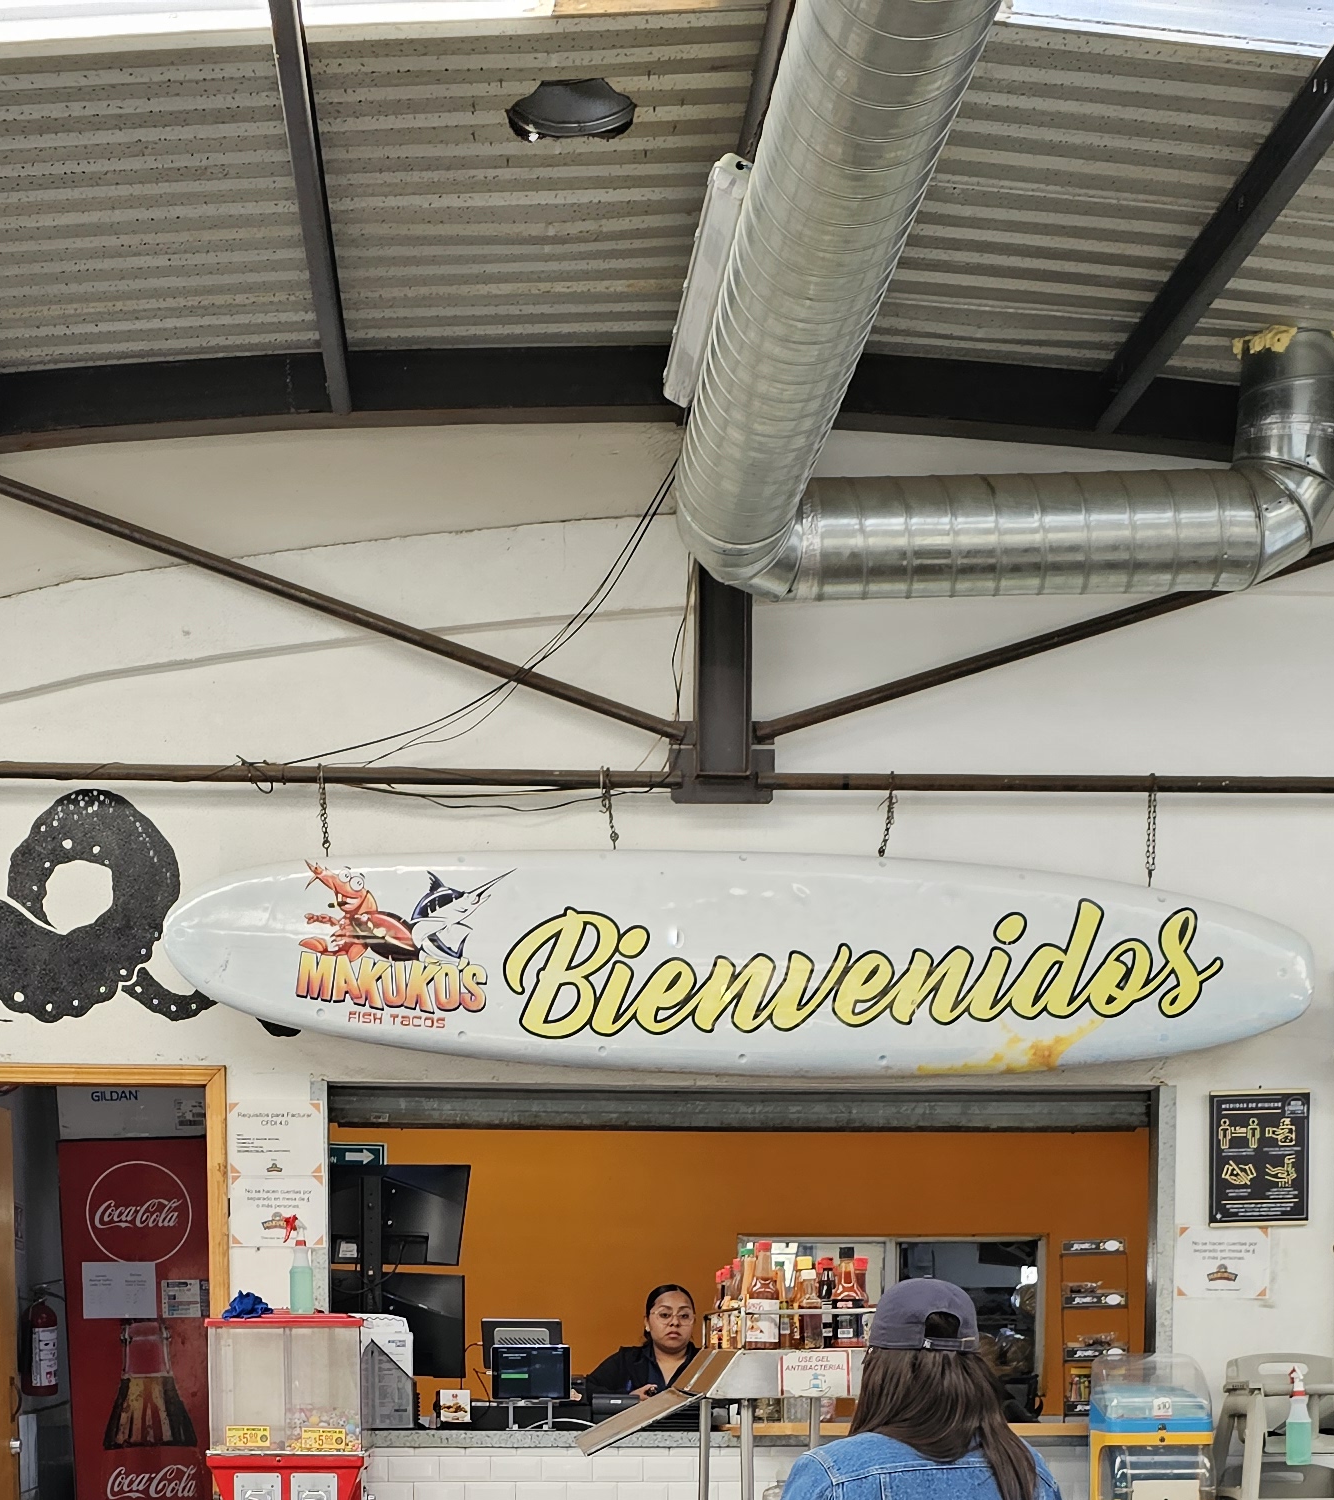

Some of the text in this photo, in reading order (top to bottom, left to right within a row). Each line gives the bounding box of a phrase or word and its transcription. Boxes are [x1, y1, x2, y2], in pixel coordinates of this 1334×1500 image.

[503, 897, 1223, 1040] Bienvenidos
[296, 951, 487, 1014] MAKUKO'S
[347, 1010, 384, 1025] FISH
[91, 1090, 139, 1102] GILDAN
[94, 1198, 183, 1228] Coca-Cola
[785, 1364, 846, 1372] ANTIBACTERIAL
[798, 1355, 830, 1363] USE GEL
[107, 1465, 198, 1500] Coca-Cola
